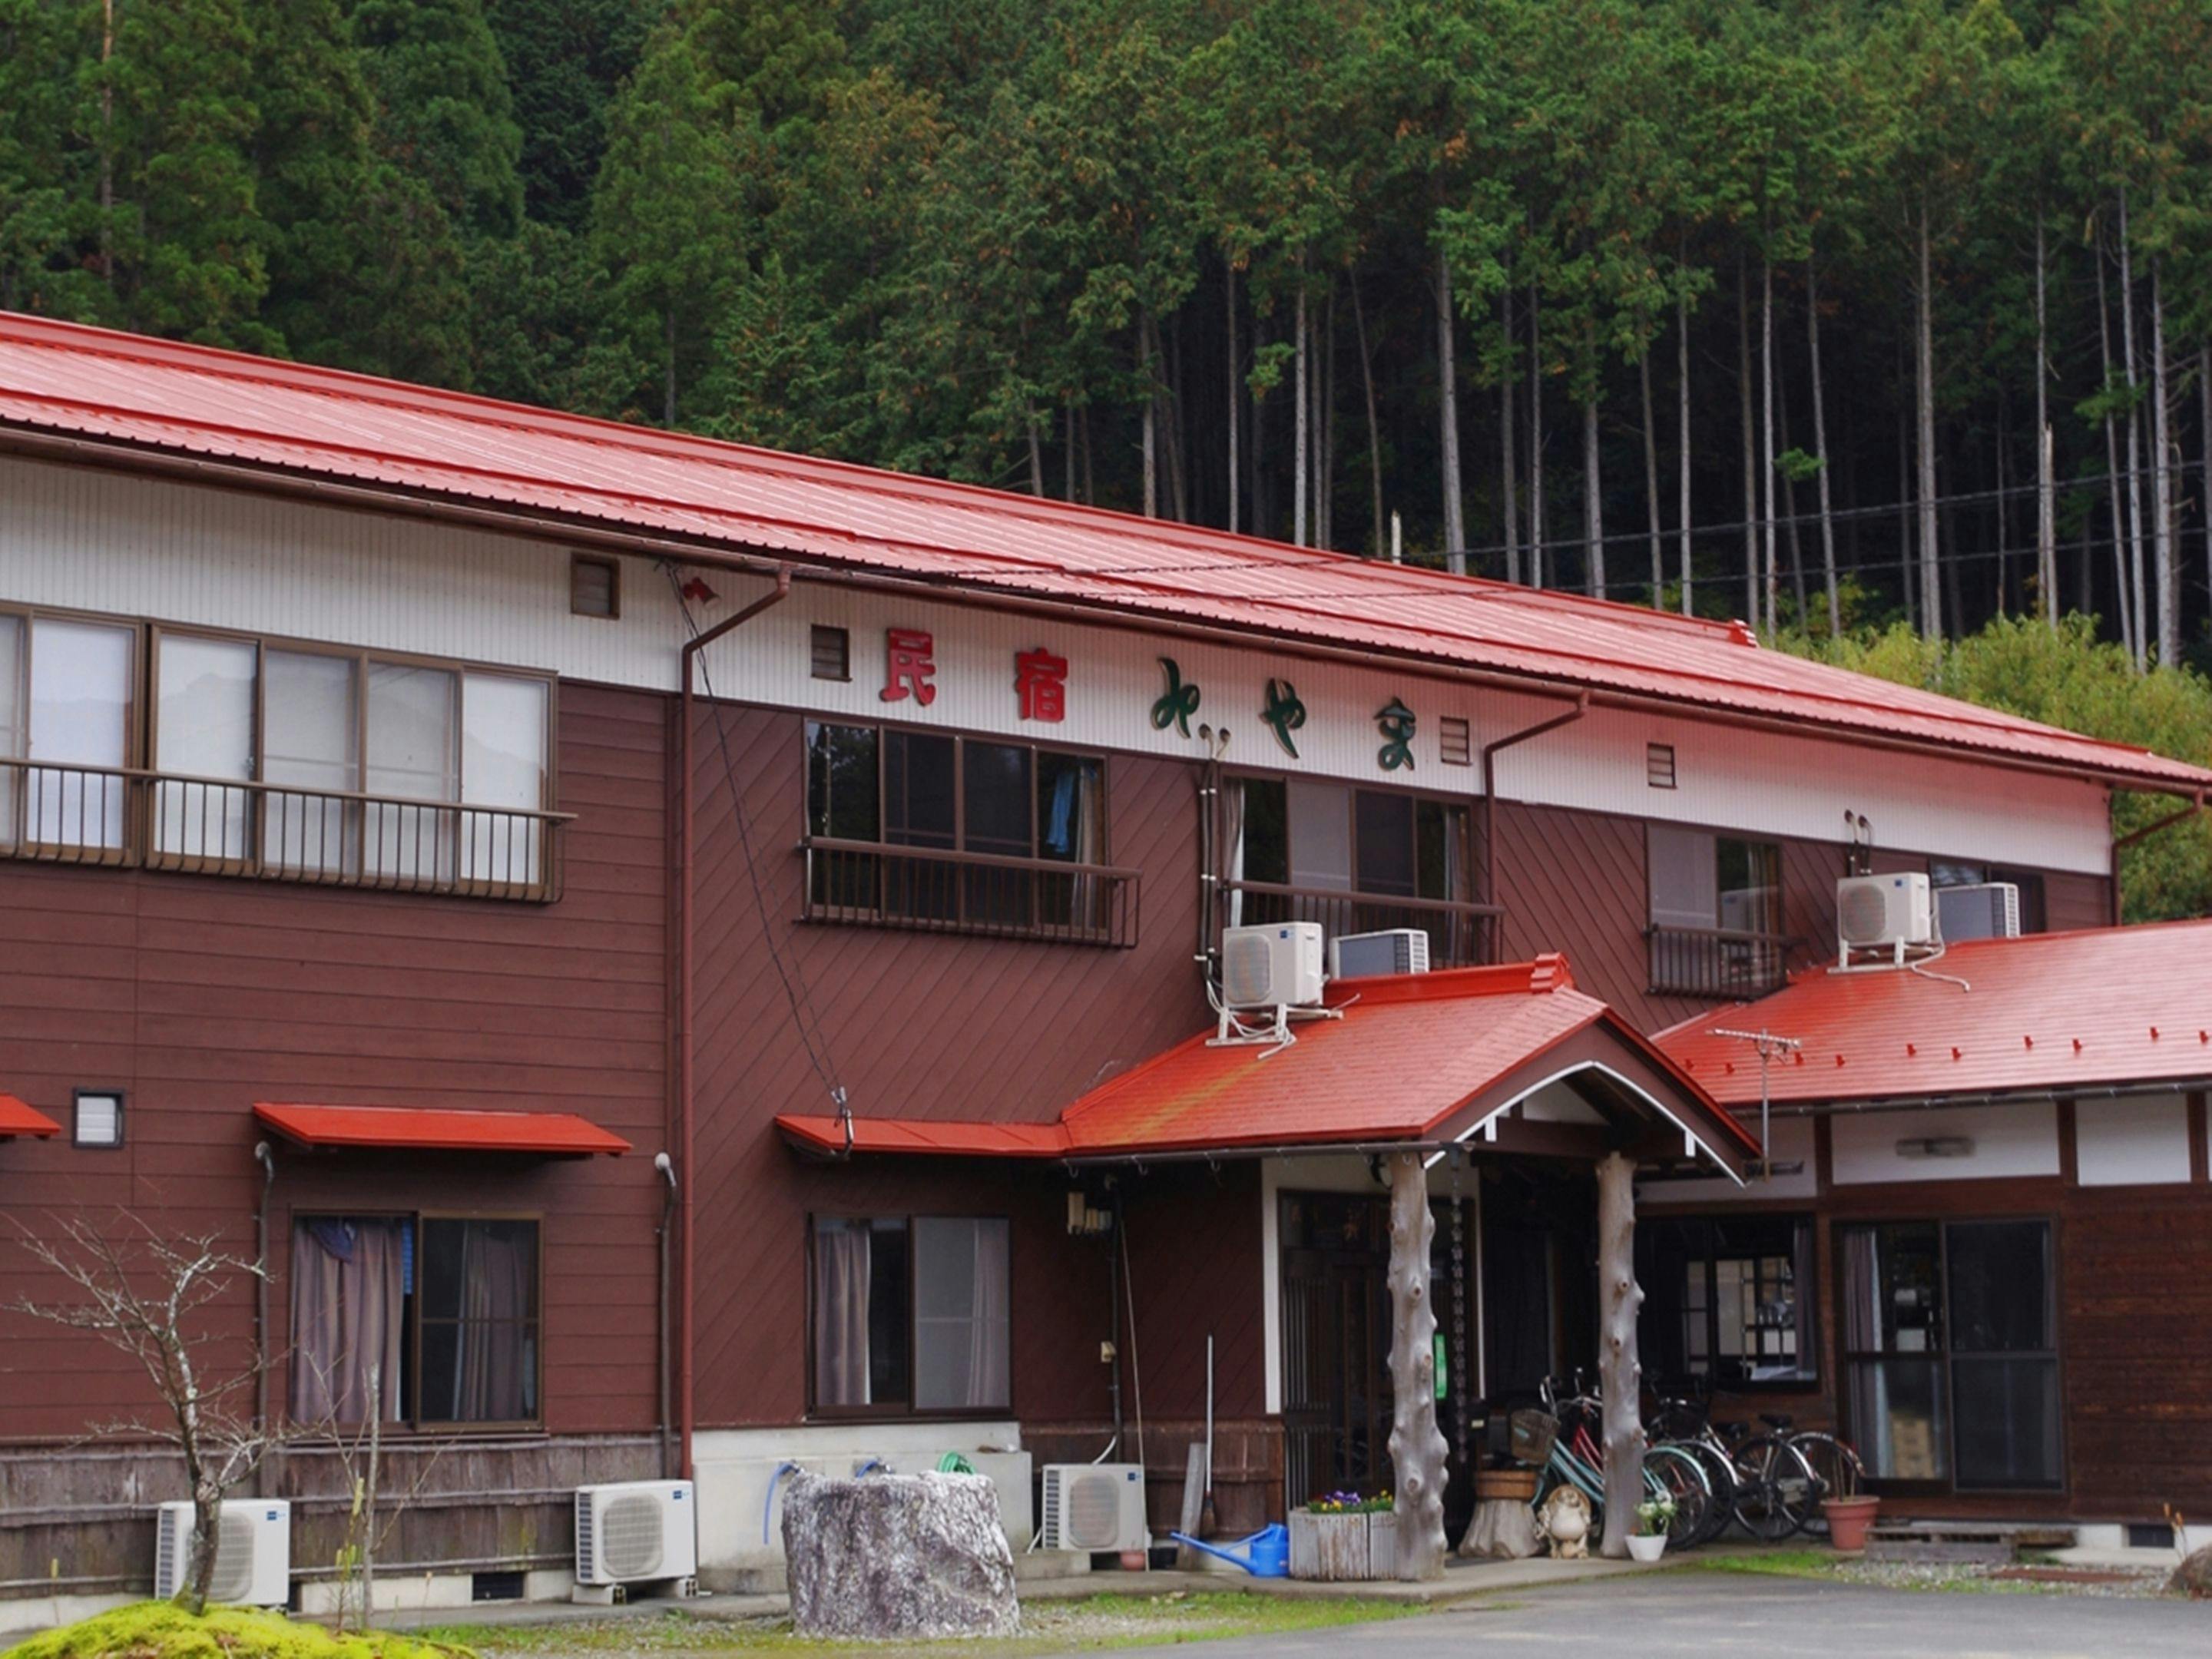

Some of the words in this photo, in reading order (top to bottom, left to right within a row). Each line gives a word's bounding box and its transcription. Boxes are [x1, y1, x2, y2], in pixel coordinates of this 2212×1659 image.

[879, 628, 1068, 723] 民宿
[1151, 657, 1416, 771] みやま
